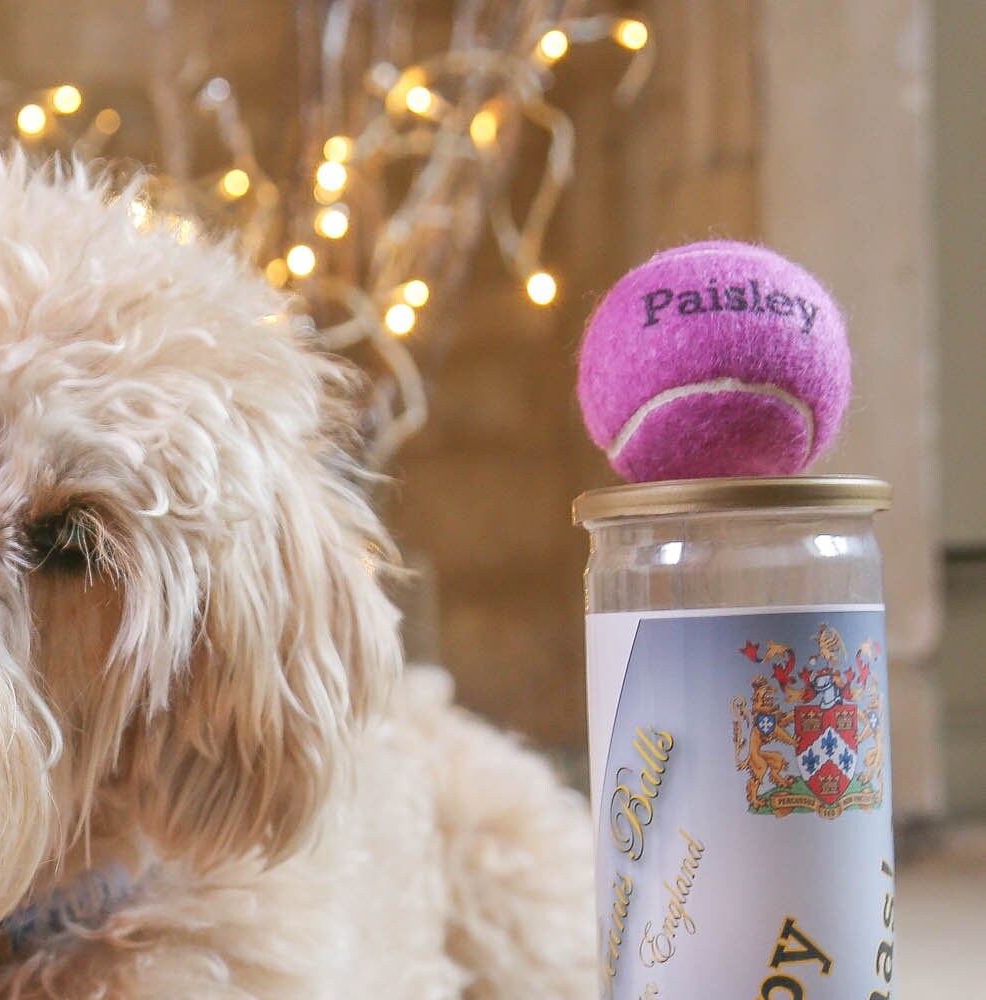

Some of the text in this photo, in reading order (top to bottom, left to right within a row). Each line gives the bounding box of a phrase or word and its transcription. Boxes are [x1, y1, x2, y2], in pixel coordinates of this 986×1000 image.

[642, 278, 819, 334] Paisley
[608, 723, 675, 861] Balls
[638, 828, 707, 968] England
